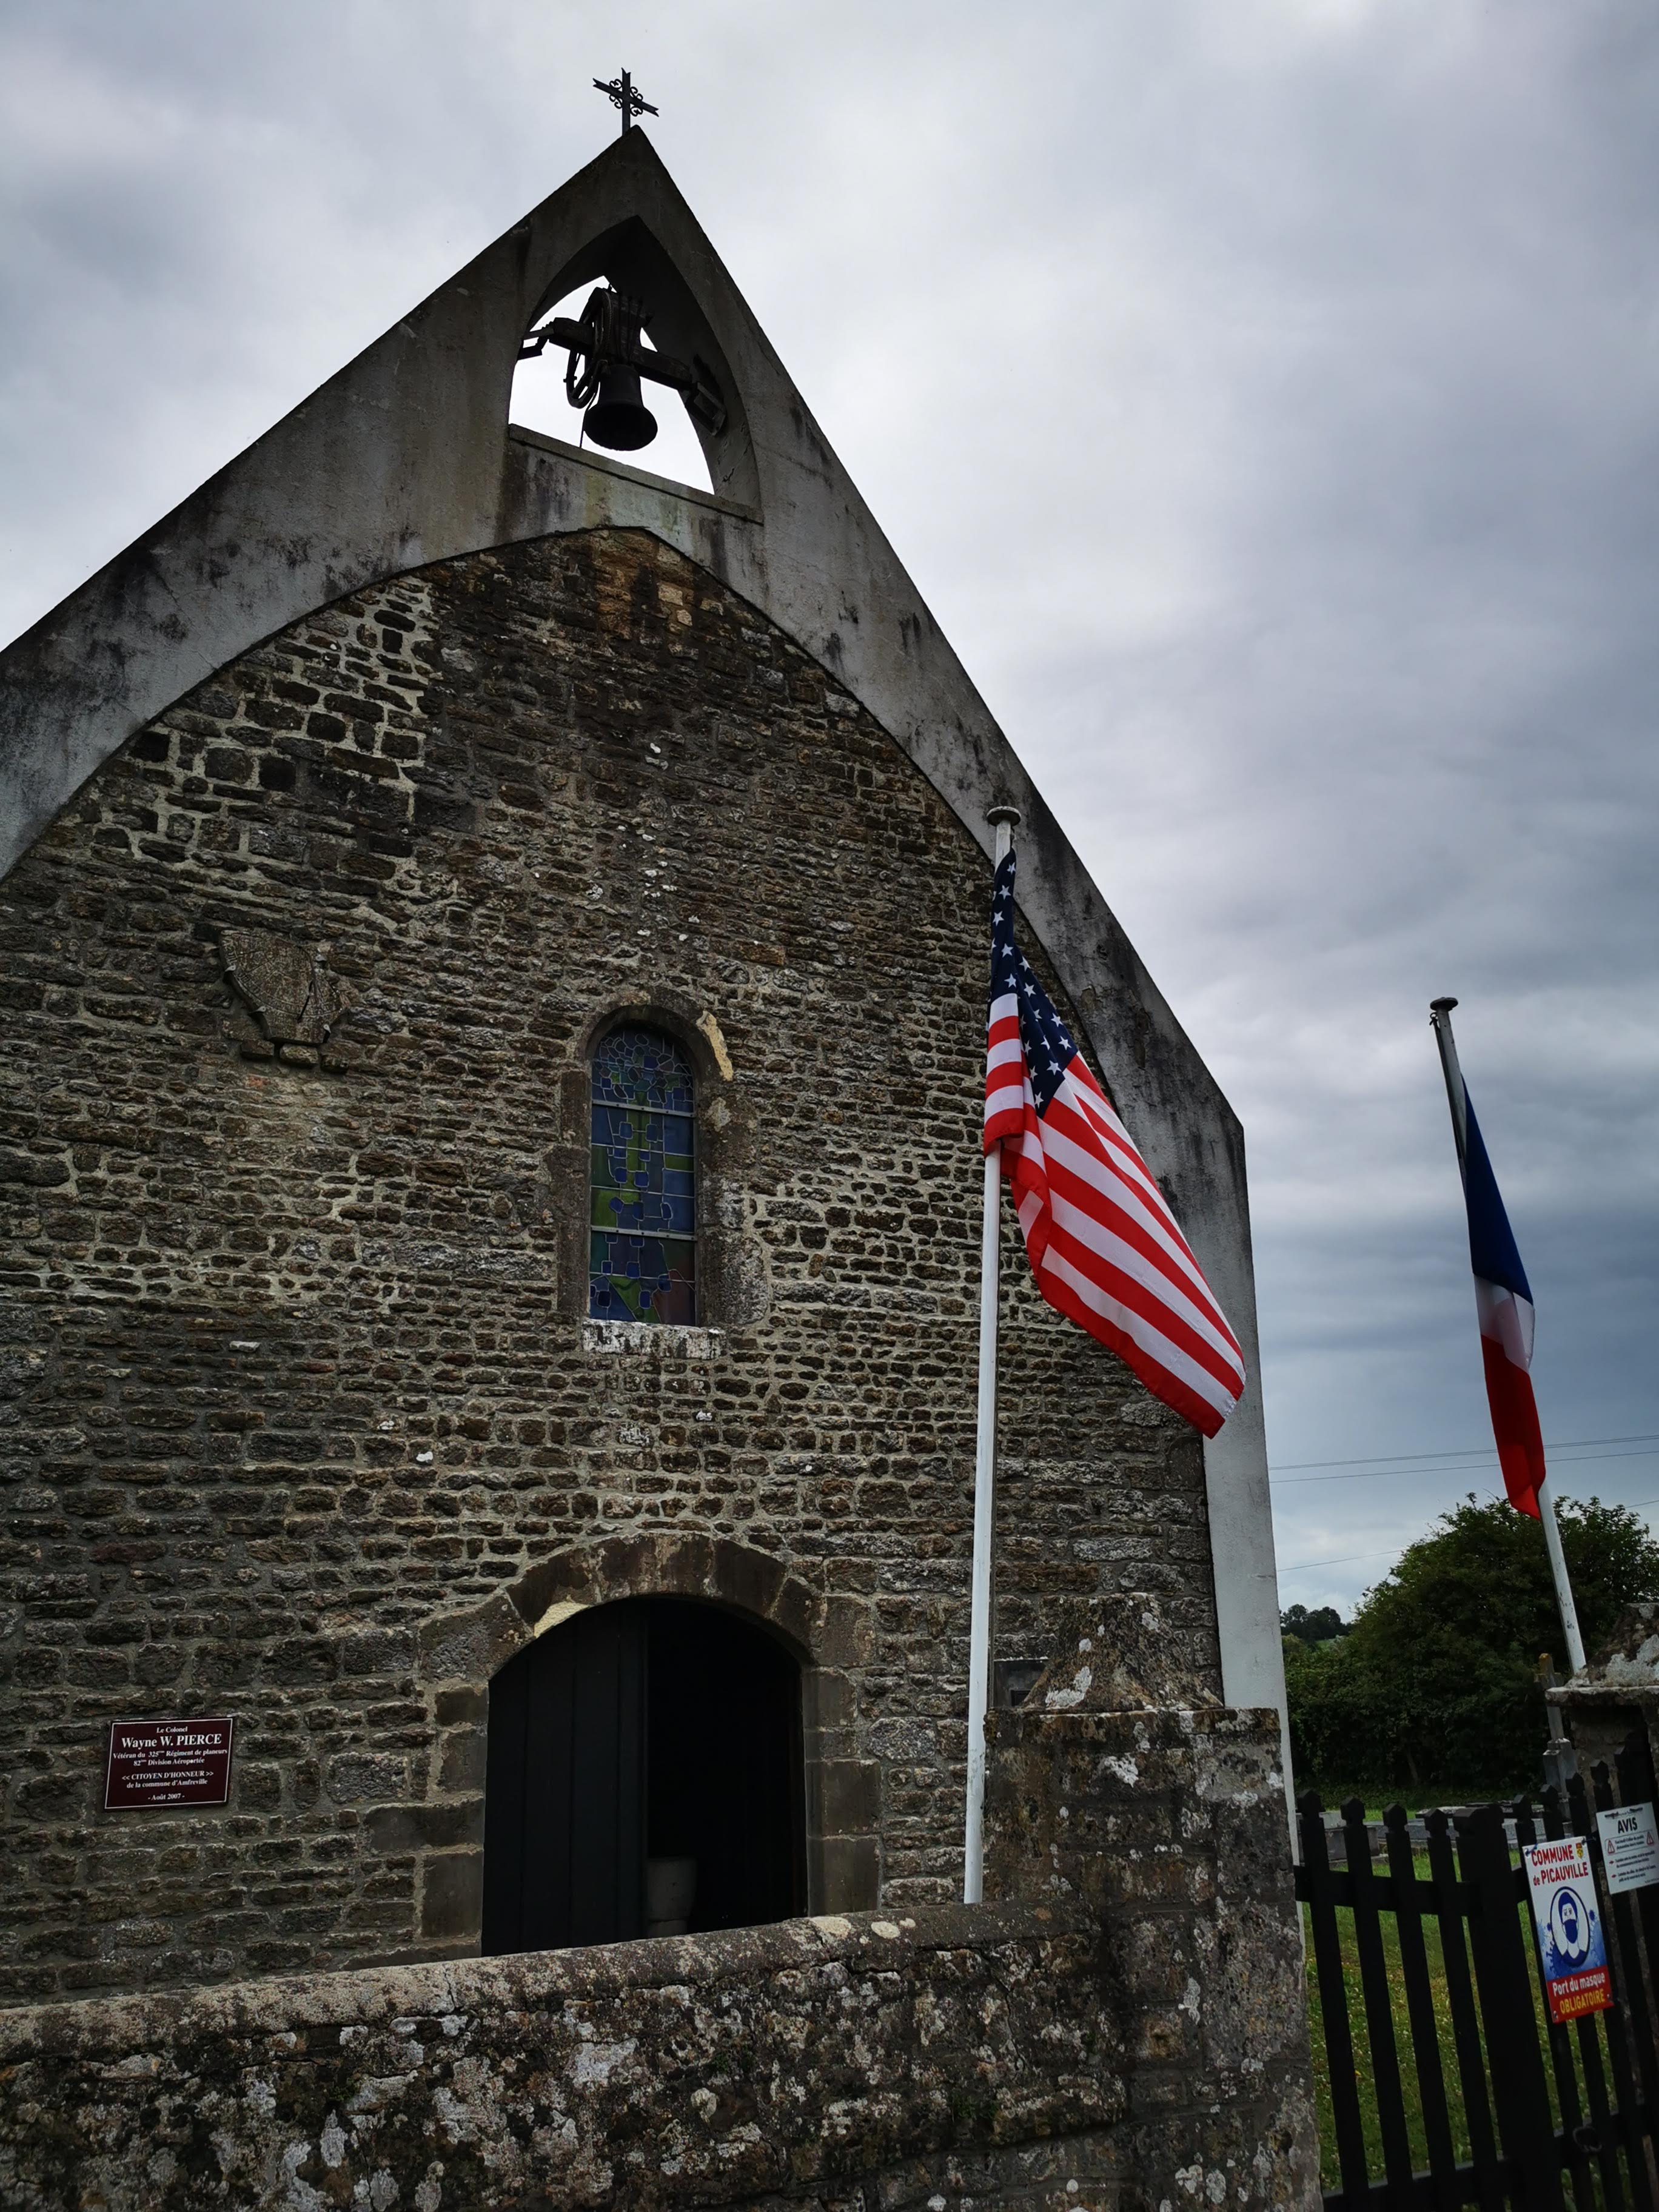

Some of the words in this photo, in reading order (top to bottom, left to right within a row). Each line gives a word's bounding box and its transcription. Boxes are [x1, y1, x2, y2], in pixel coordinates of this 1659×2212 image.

[122, 1737, 157, 1750] Wayne
[160, 1735, 173, 1746] W.
[176, 1734, 222, 1746] PIERCE
[1618, 1817, 1638, 1834] AVIS
[1531, 1845, 1574, 1866] COMMUNE
[1533, 1875, 1540, 1886] de
[1541, 1862, 1589, 1885] PICAUVILLE
[1552, 1979, 1569, 1997] Port
[1569, 1977, 1579, 1992] du
[1579, 1972, 1606, 1988] masque
[1560, 1988, 1606, 2014] OBLIGATOIRE
